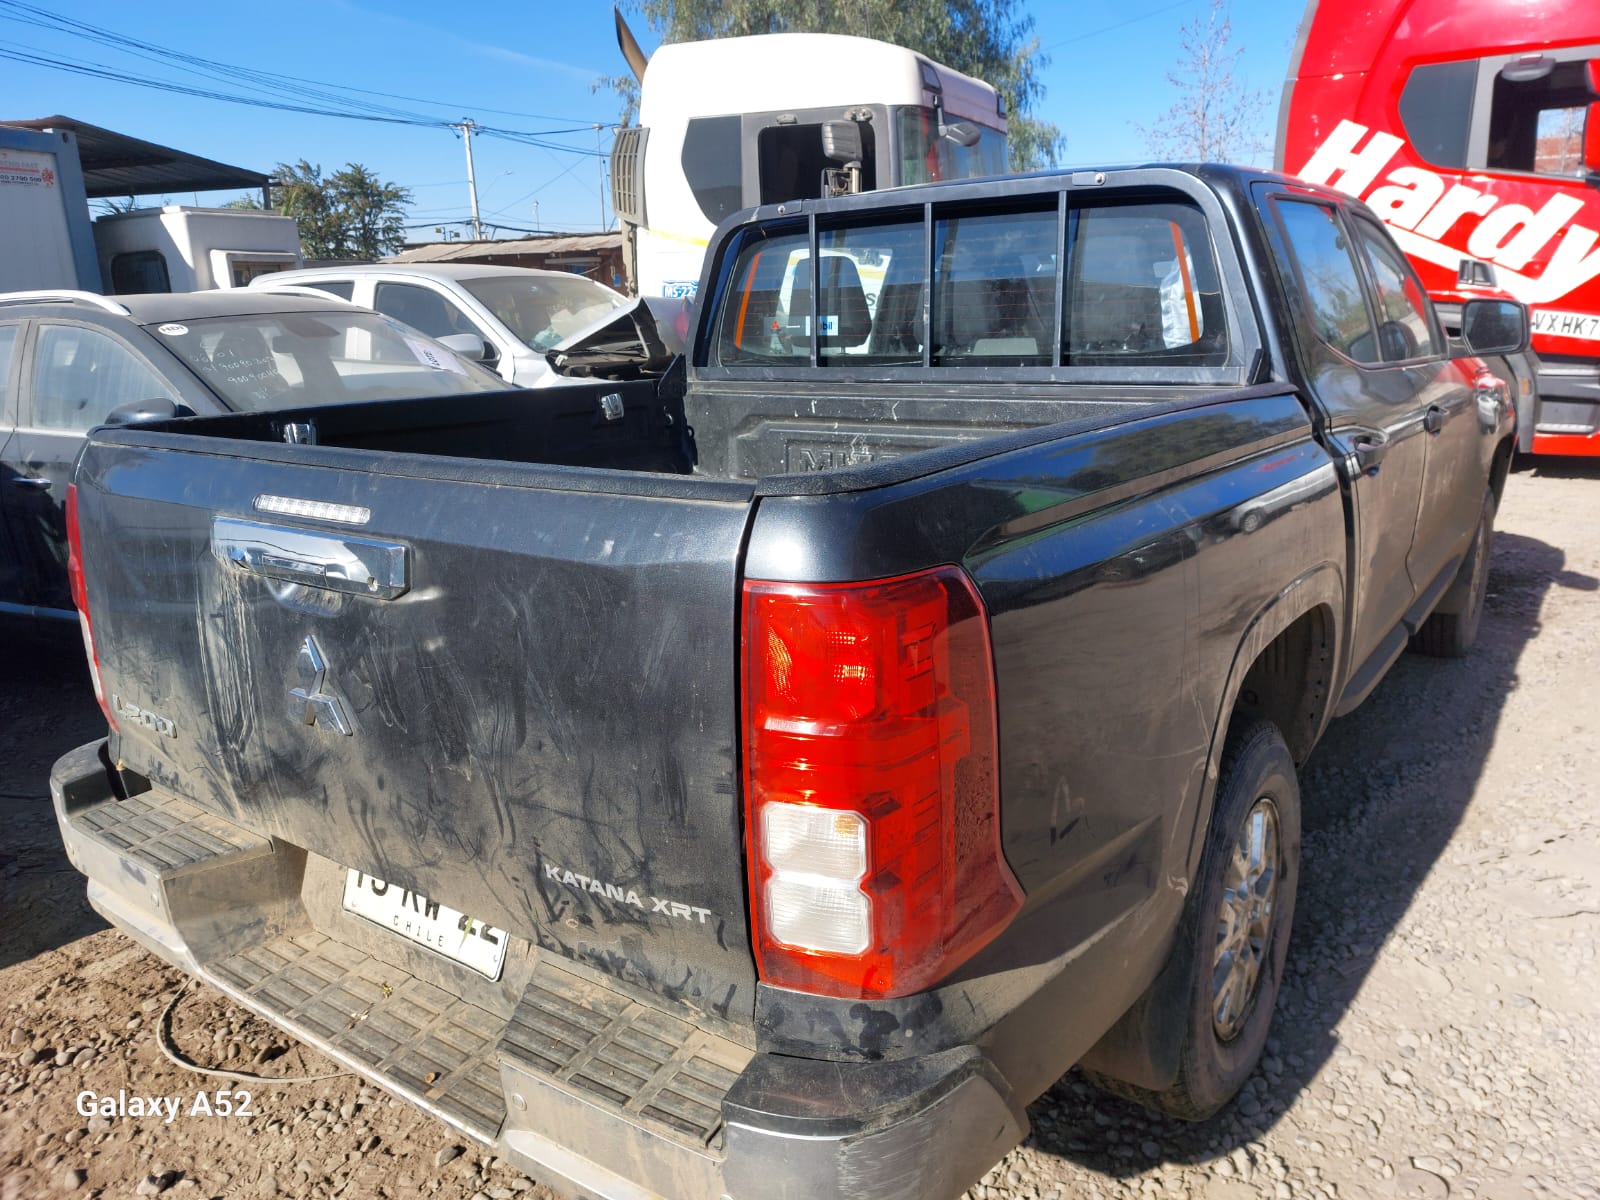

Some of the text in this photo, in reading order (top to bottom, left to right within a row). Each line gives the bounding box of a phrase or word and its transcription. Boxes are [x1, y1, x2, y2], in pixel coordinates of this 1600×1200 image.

[1297, 119, 1600, 300] Hardy
[545, 863, 712, 924] KATANA XRT
[393, 914, 445, 948] CHILE
